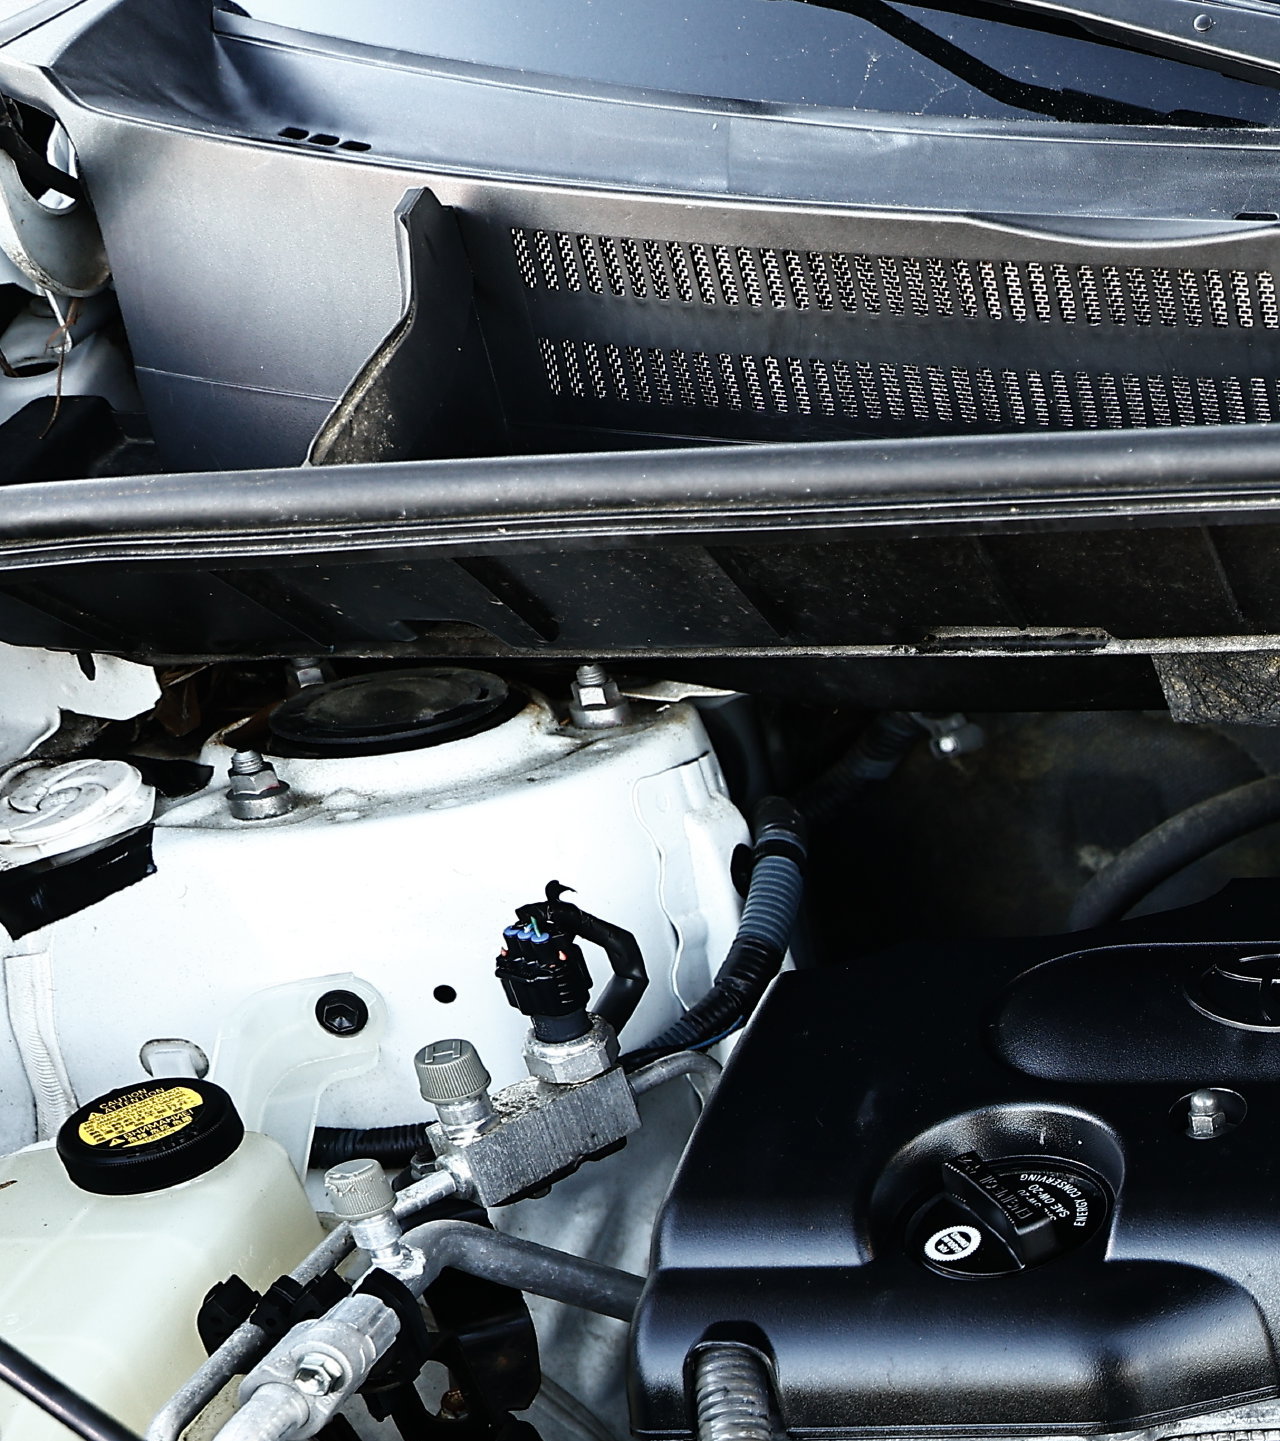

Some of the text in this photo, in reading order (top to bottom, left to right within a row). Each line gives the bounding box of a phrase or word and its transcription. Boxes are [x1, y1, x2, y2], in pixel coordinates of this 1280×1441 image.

[99, 1088, 147, 1109] CAUTION
[105, 1087, 165, 1114] ATTENTION
[1020, 1174, 1089, 1227] ENERGY CONSERVING
[1050, 1203, 1070, 1218] SAE
